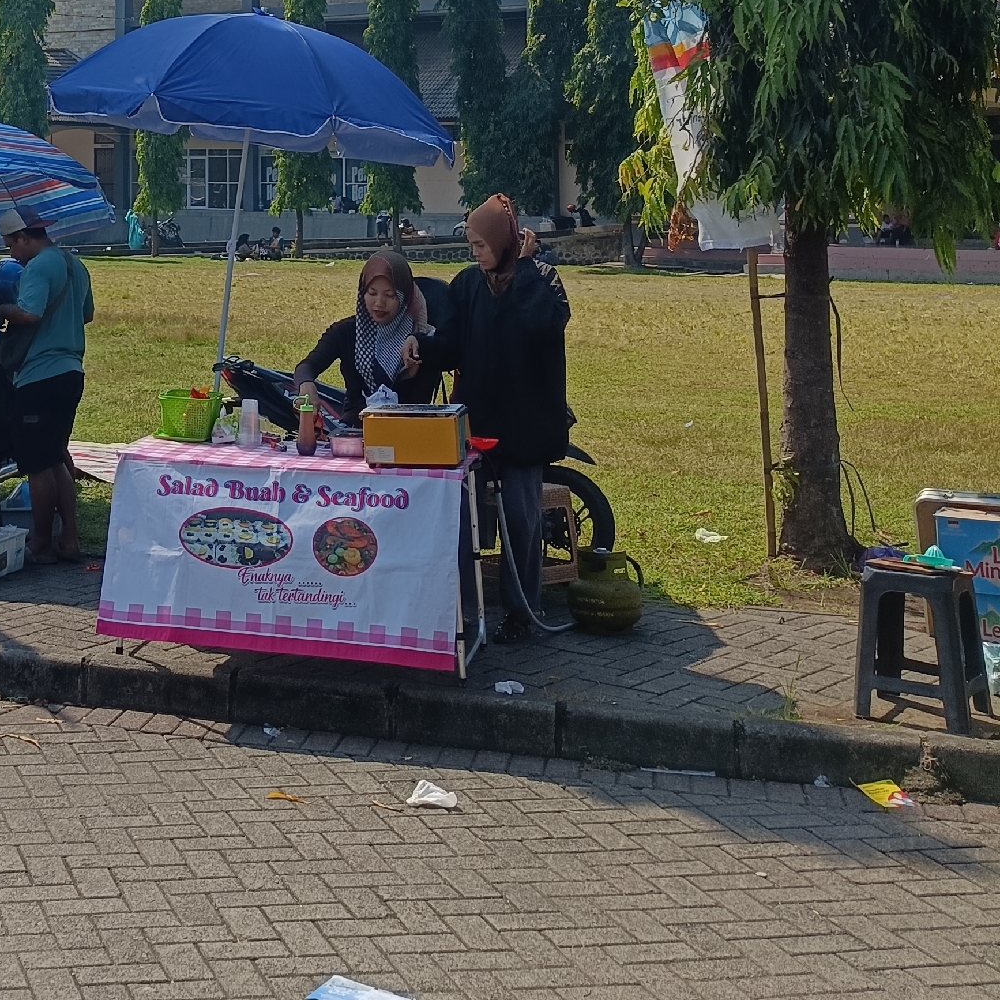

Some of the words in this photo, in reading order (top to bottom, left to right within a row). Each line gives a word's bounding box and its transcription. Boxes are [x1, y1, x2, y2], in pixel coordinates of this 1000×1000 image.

[157, 473, 220, 498] Salad
[223, 479, 286, 504] Buah
[291, 483, 312, 504] &
[316, 485, 411, 513] Seafood
[237, 566, 293, 588] Enaknya
[254, 586, 277, 604] tak
